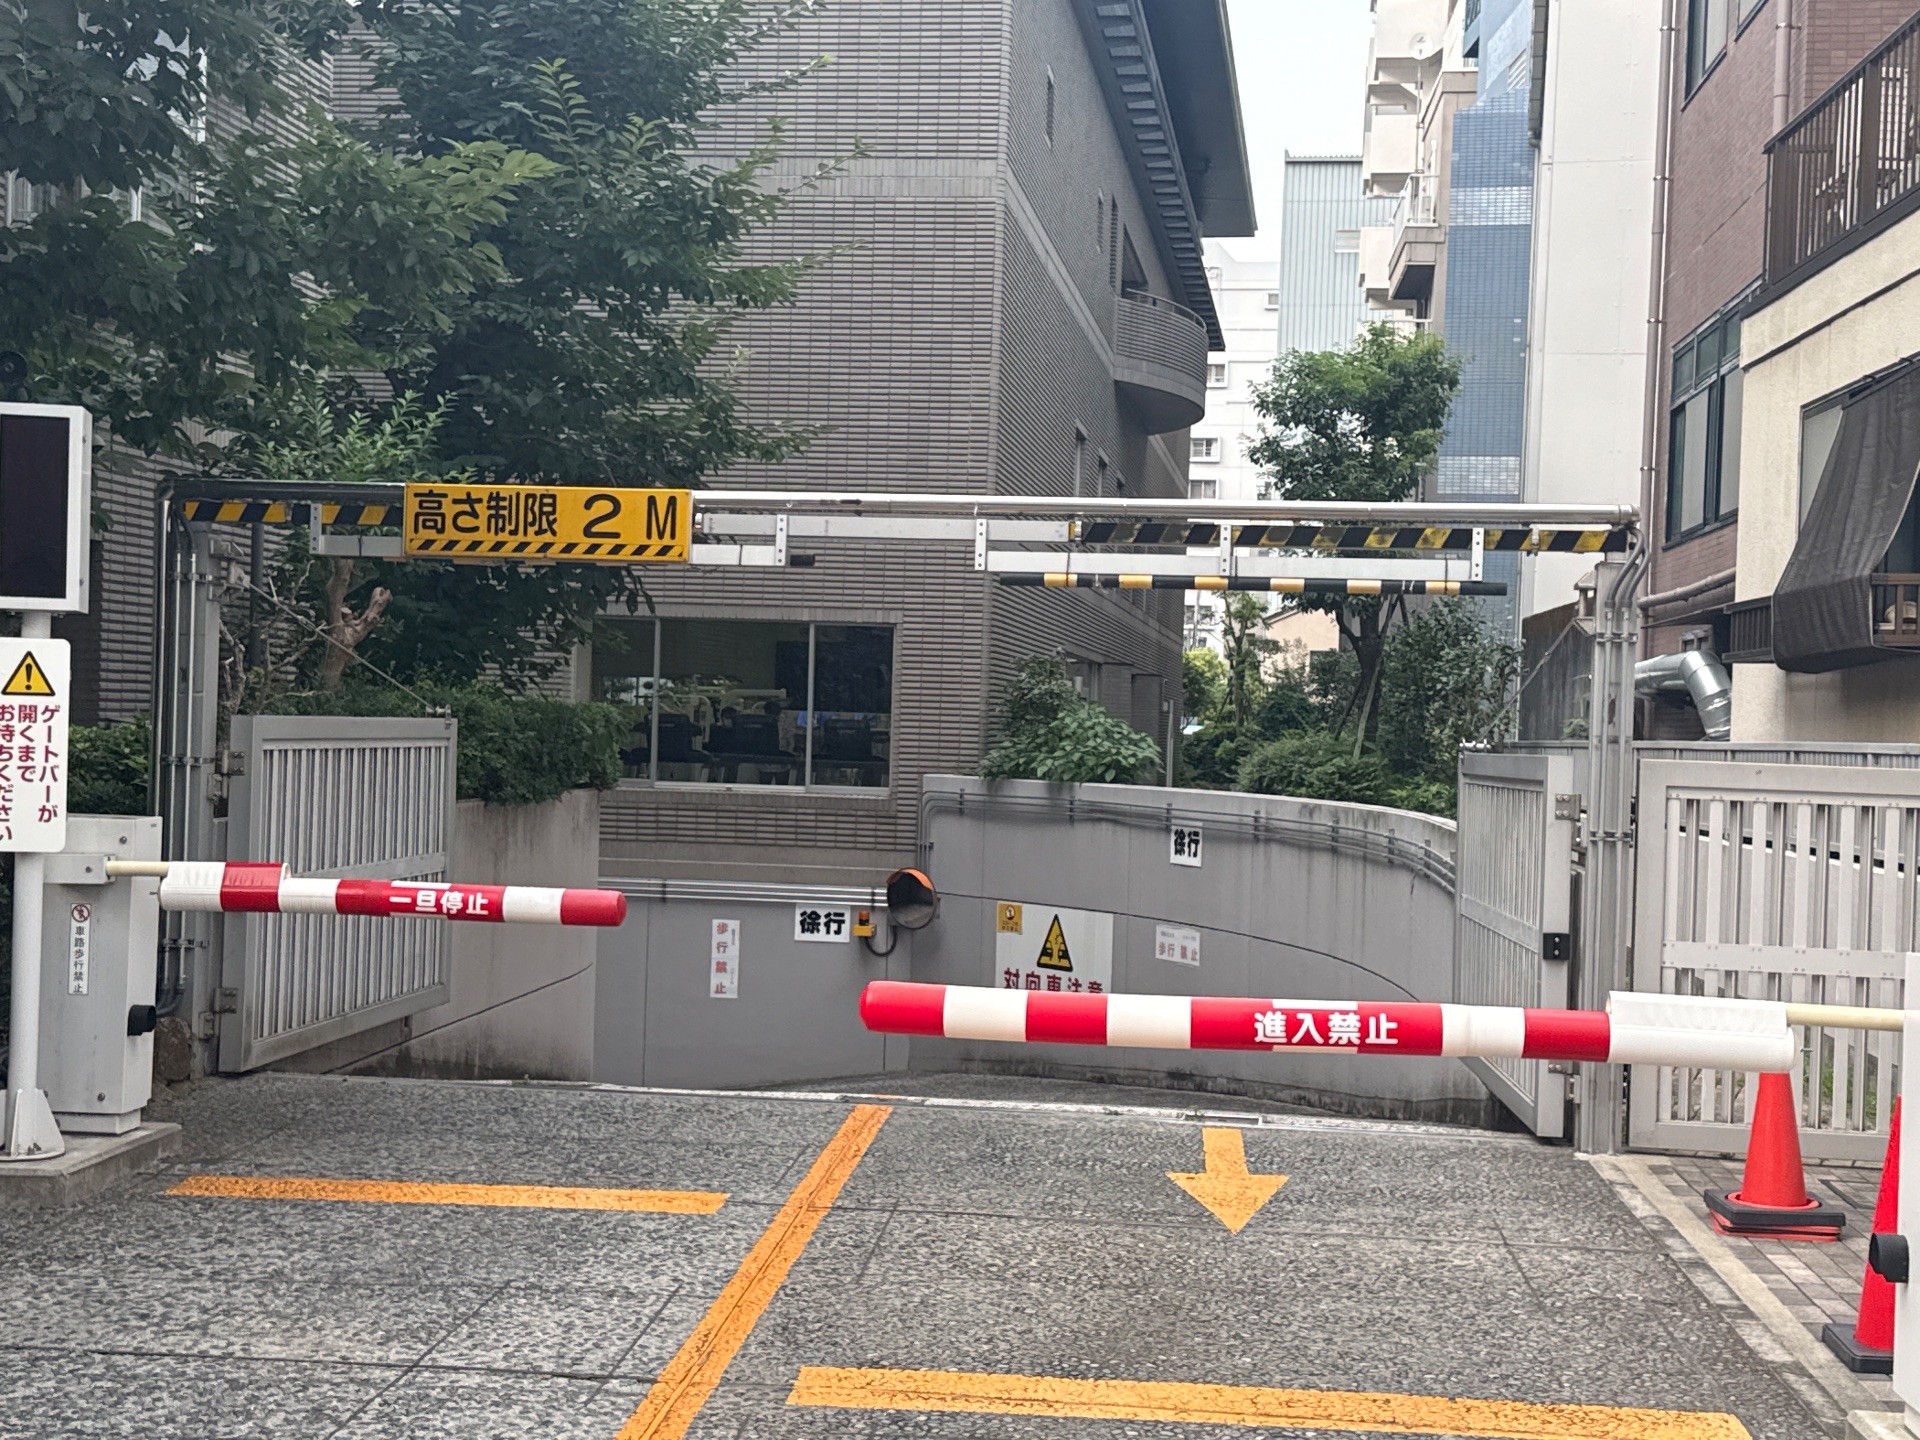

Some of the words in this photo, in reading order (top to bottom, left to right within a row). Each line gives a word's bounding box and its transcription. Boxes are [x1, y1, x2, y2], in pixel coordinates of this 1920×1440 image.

[413, 489, 557, 537] 高さ制限
[582, 493, 622, 539] 2
[646, 495, 678, 541] M
[17, 704, 37, 783] 開くまで
[39, 704, 61, 822] ゲートバーが
[1174, 828, 1200, 858] 徐行
[389, 890, 489, 916] 一旦停止
[799, 910, 846, 936] 徐行
[73, 926, 86, 993] 車路歩行禁止
[714, 922, 729, 994] 歩行禁止
[1254, 1010, 1399, 1045] 進入禁止
